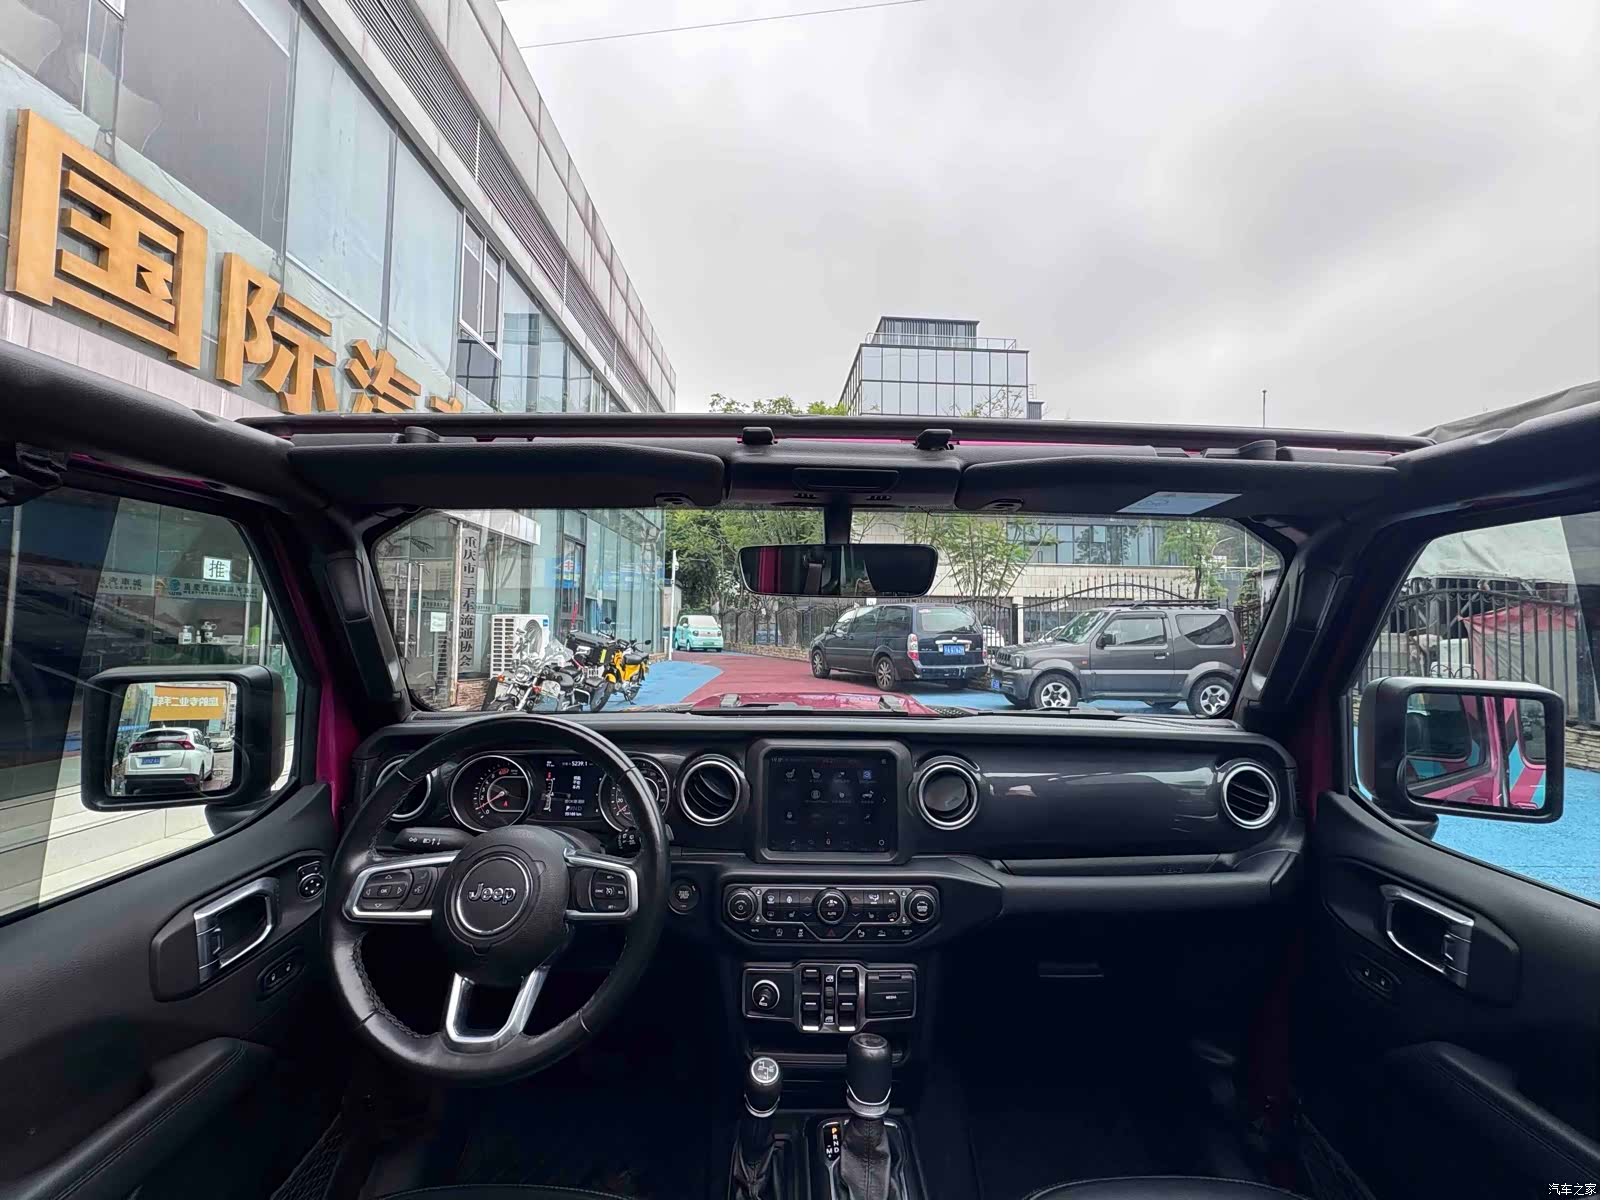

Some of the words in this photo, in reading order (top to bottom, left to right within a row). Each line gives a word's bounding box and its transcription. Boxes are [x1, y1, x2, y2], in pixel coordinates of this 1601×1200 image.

[208, 560, 226, 578] 推
[459, 536, 477, 667] 重庆市二手车流通协会
[468, 882, 517, 905] Jeep
